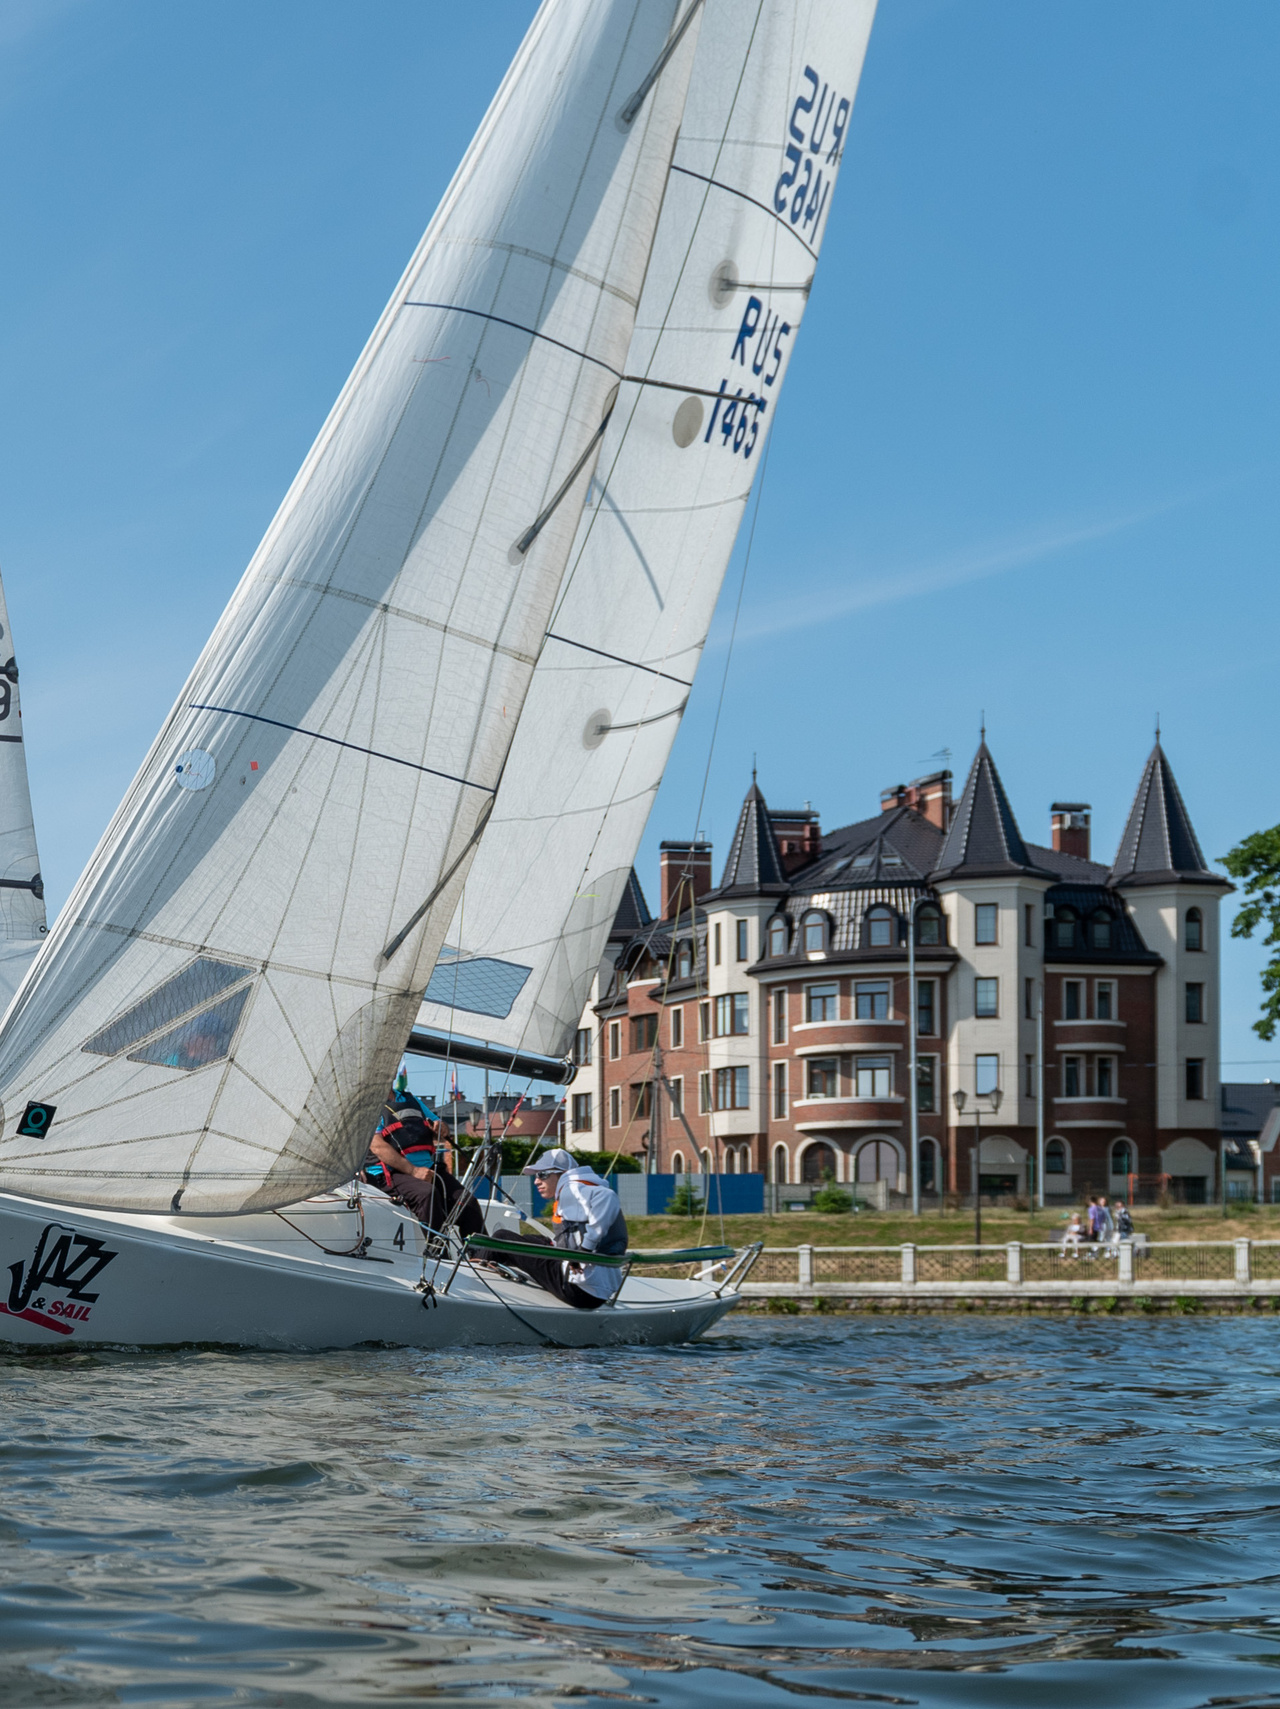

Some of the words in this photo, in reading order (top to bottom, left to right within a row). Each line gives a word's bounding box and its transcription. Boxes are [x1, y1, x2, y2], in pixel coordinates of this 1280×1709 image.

[731, 295, 791, 387] RUS
[703, 378, 768, 459] 1465
[7, 1222, 120, 1313] JAZZ
[393, 1222, 406, 1251] 4
[31, 1297, 46, 1309] &
[47, 1301, 92, 1322] SAIL
